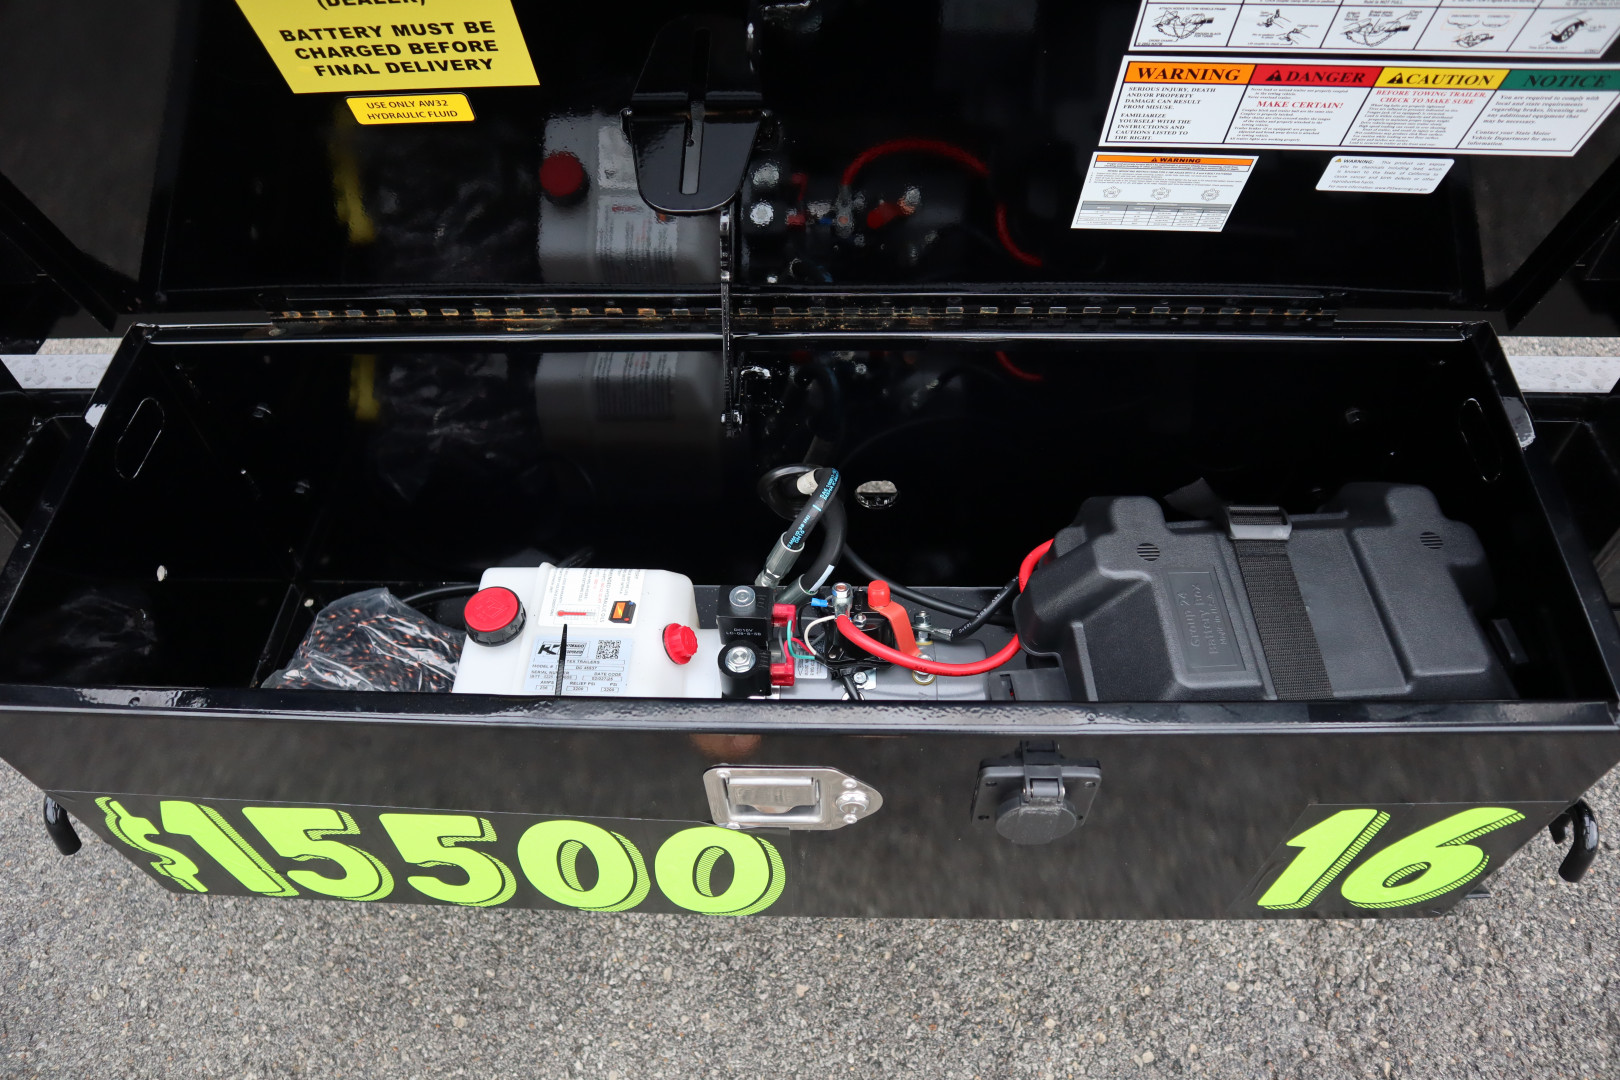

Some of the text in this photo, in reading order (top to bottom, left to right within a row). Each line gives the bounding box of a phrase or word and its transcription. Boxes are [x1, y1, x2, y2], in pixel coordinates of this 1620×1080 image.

[279, 20, 495, 42] BATTERY MUST BE
[295, 40, 499, 59] CHARGED BEFORE
[314, 59, 493, 77] FINAL DELIVERY
[1138, 67, 1241, 81] WARNING
[1286, 71, 1366, 83] DANGER
[1406, 74, 1495, 86] CAUTION
[1524, 75, 1612, 87] NOTICE
[367, 101, 387, 109] USE
[388, 100, 416, 109] ONLY
[367, 110, 457, 120] HYDRAULIC FLUID
[1178, 592, 1200, 647] Group 24
[1192, 584, 1220, 654] Battery Box
[95, 797, 786, 917] $15500
[1257, 807, 1526, 910] 16
